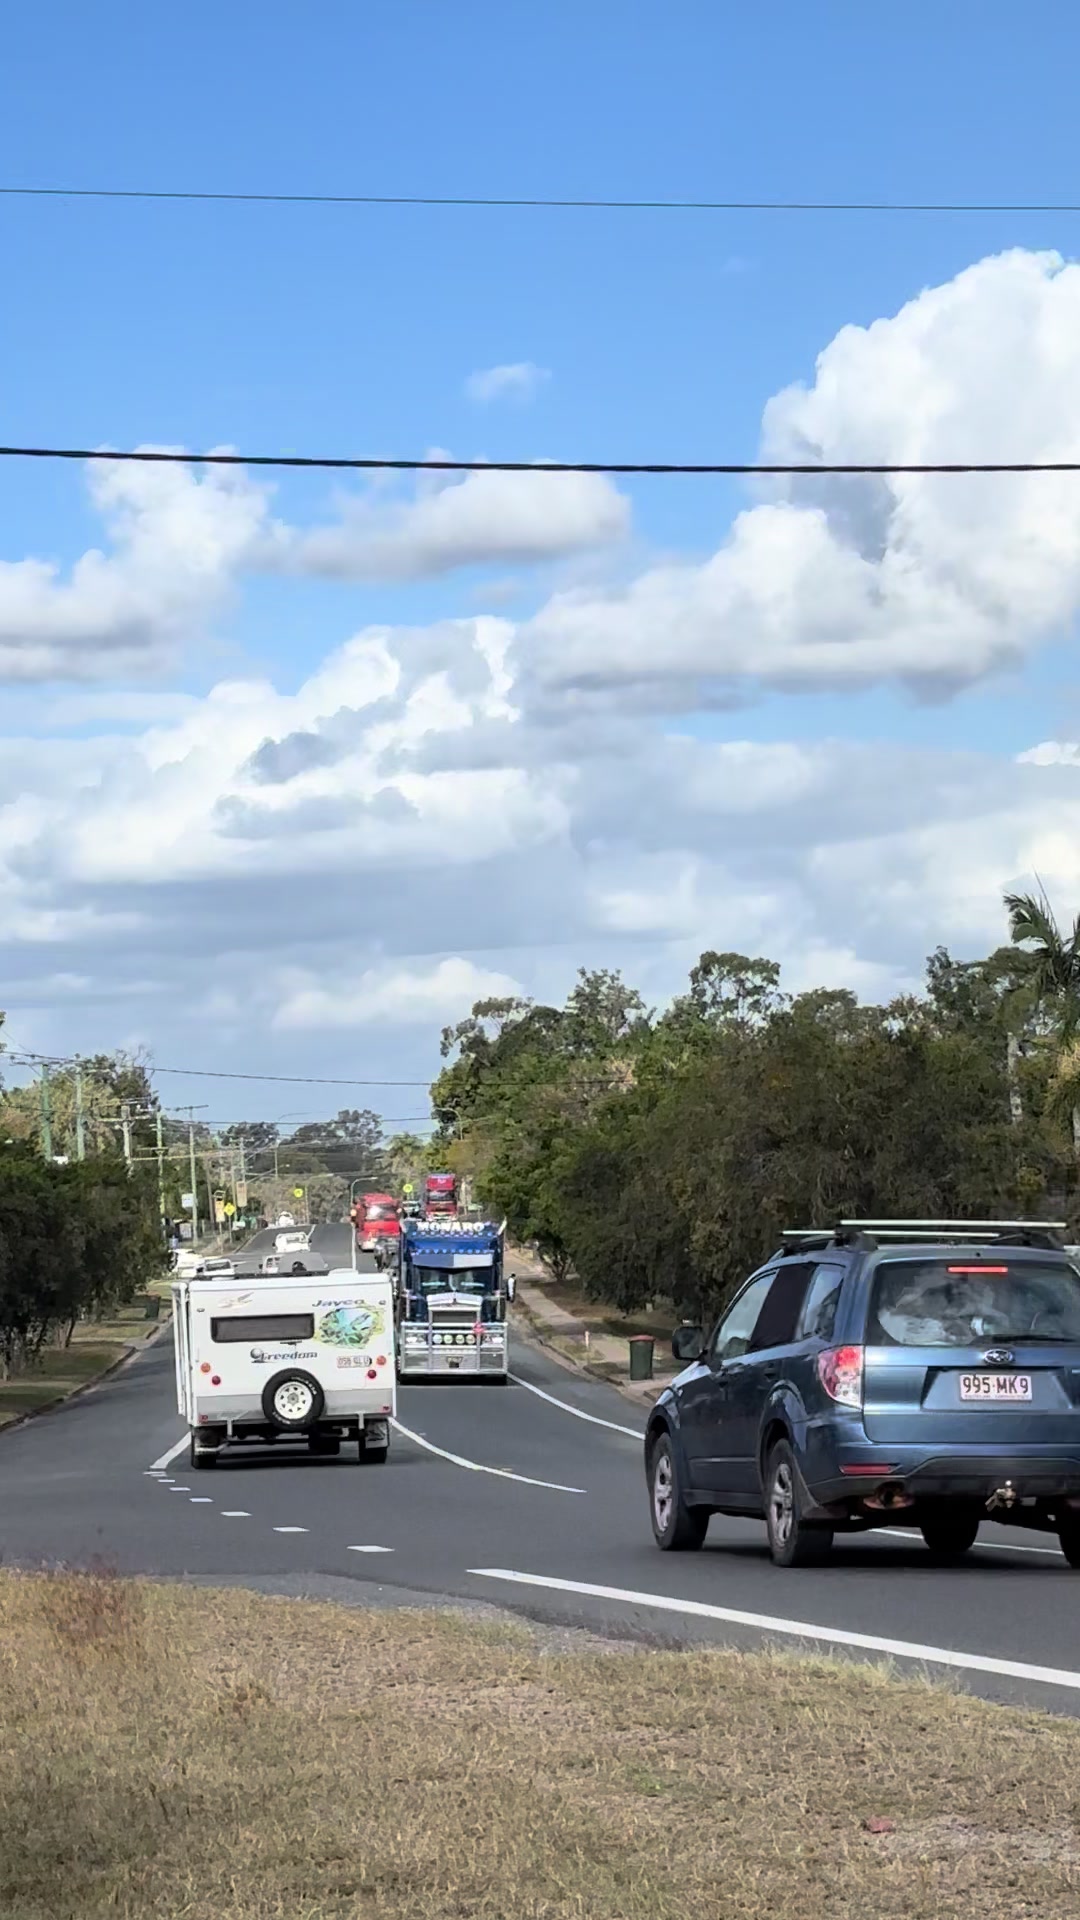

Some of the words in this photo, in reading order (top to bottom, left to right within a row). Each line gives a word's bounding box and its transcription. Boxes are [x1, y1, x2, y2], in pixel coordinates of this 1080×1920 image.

[416, 1221, 484, 1232] MONARO
[312, 1299, 365, 1308] Jayco
[259, 1350, 319, 1361] Freedom
